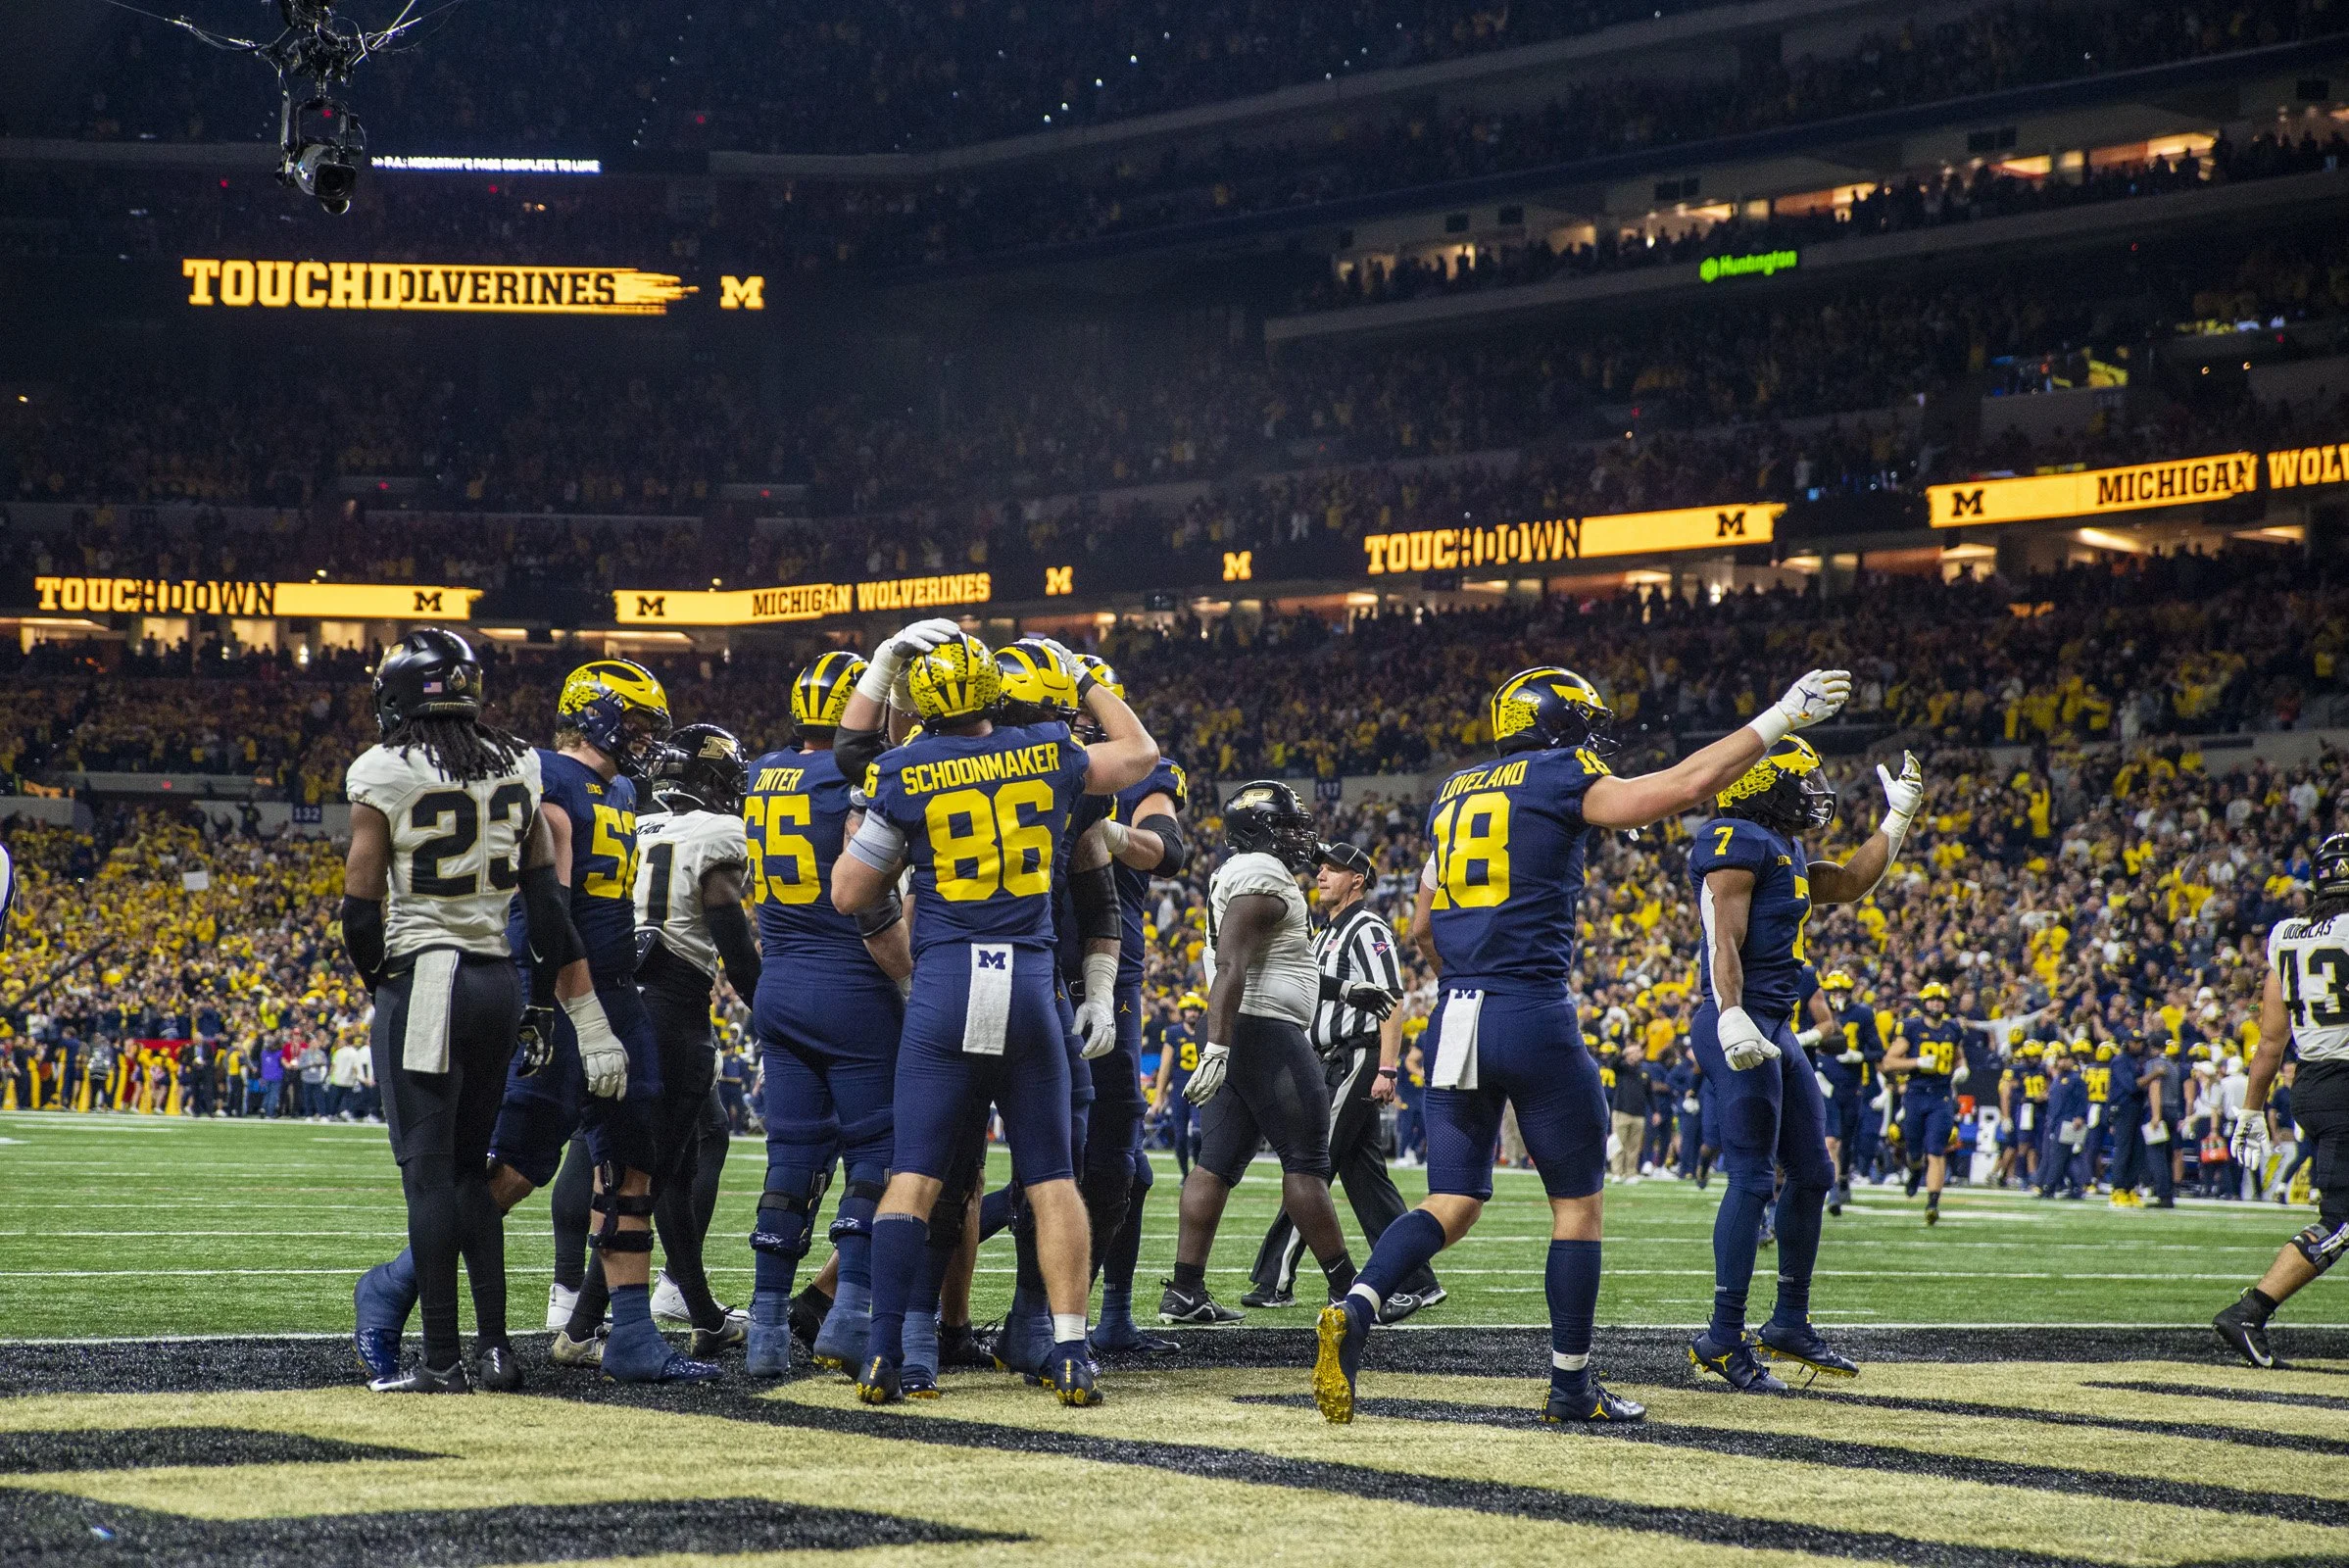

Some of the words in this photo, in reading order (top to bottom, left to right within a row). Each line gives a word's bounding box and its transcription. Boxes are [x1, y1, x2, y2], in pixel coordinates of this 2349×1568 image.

[1721, 250, 1797, 275] Huntington
[720, 276, 764, 309] M
[1952, 489, 1984, 517] M
[2096, 454, 2257, 505] MICHIGAN
[1717, 511, 1747, 537] M
[1046, 566, 1073, 595] M
[1223, 552, 1251, 580] M
[414, 592, 443, 612] M
[637, 596, 665, 617] M
[752, 584, 852, 617] MICHIGAN
[857, 572, 991, 612] WOLVERINES
[753, 767, 805, 792] ZINTER
[901, 742, 1060, 796] SCHOONMAKER
[1438, 760, 1529, 805] LOVELAND
[409, 781, 533, 900] 23
[744, 794, 821, 905] 65
[924, 778, 1053, 903] 86
[1430, 791, 1511, 910] 18
[1714, 826, 1735, 856] 7
[643, 839, 676, 928] 1
[978, 950, 1006, 970] M
[2278, 947, 2349, 1027] 43
